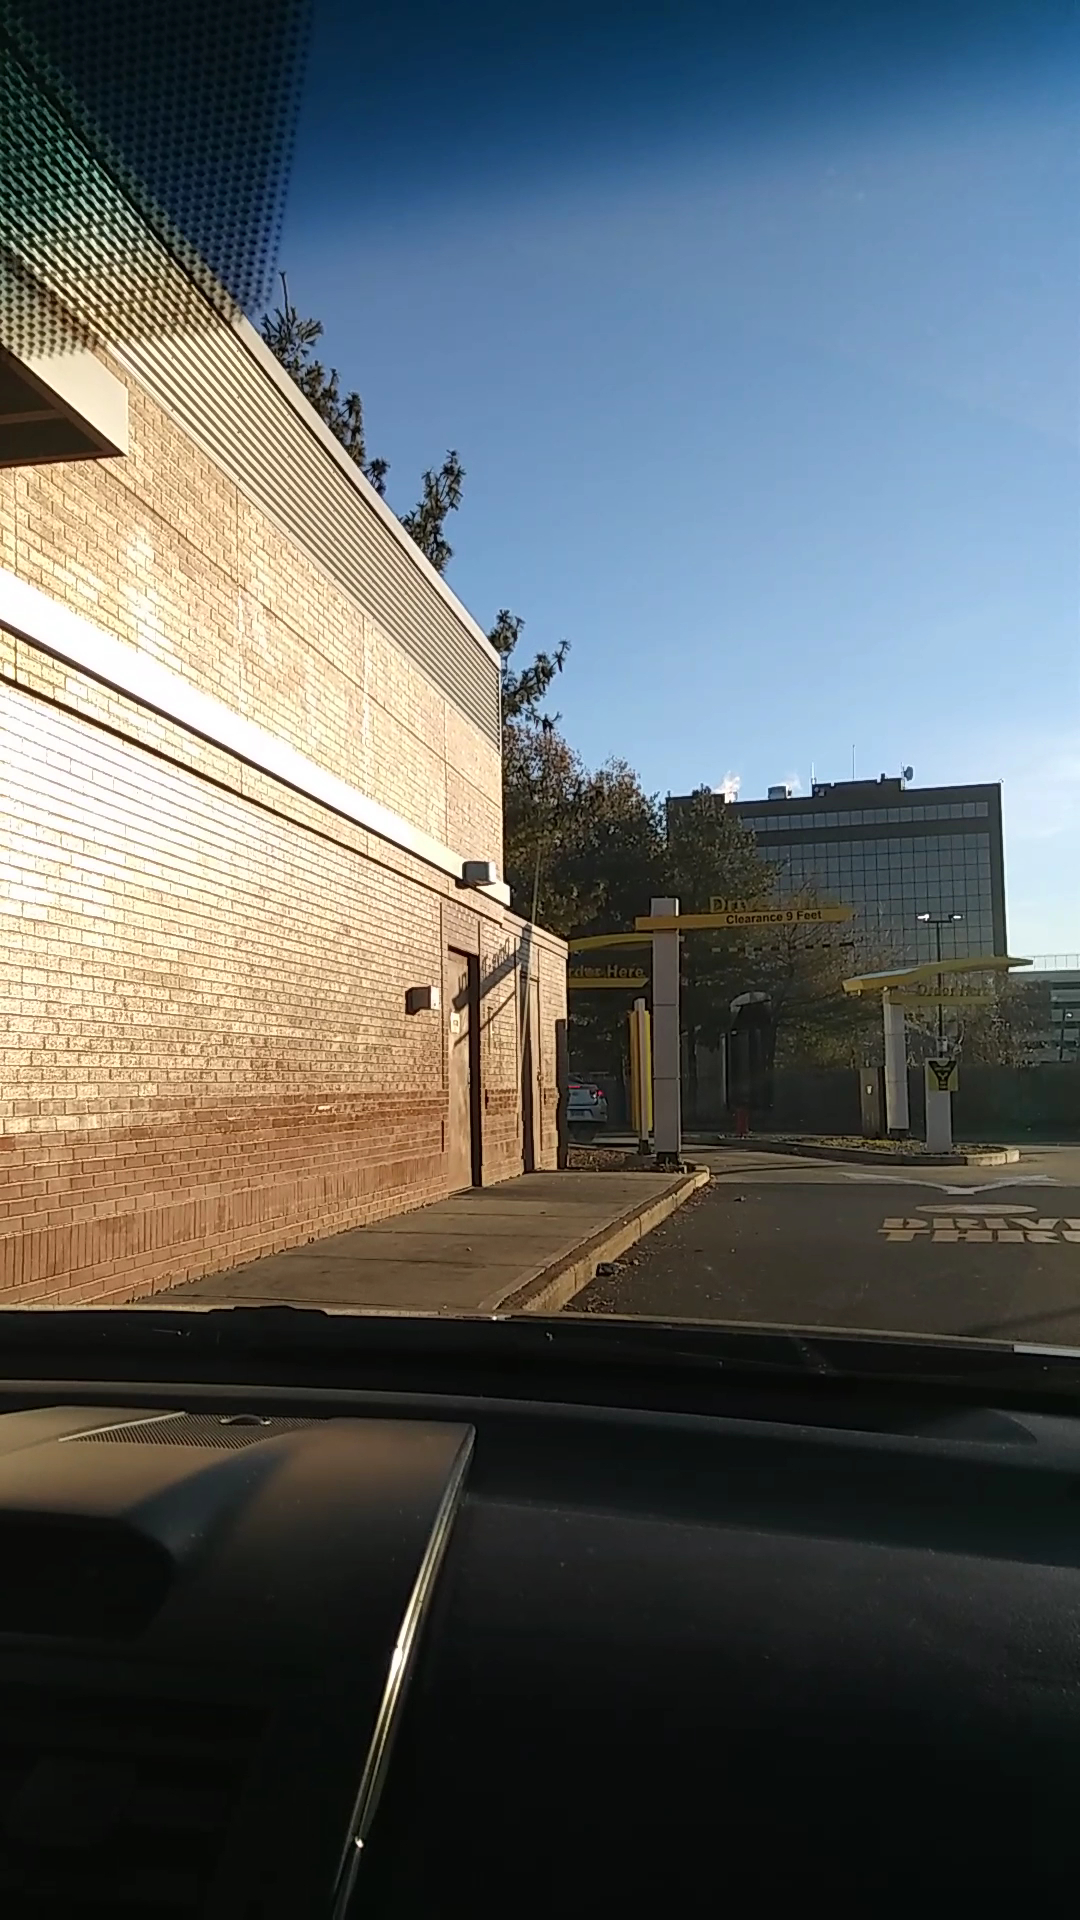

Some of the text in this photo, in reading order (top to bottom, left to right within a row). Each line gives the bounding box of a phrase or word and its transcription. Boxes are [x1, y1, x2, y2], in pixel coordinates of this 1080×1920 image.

[726, 909, 822, 925] Clearance 9 Feet
[568, 964, 644, 978] rder Here
